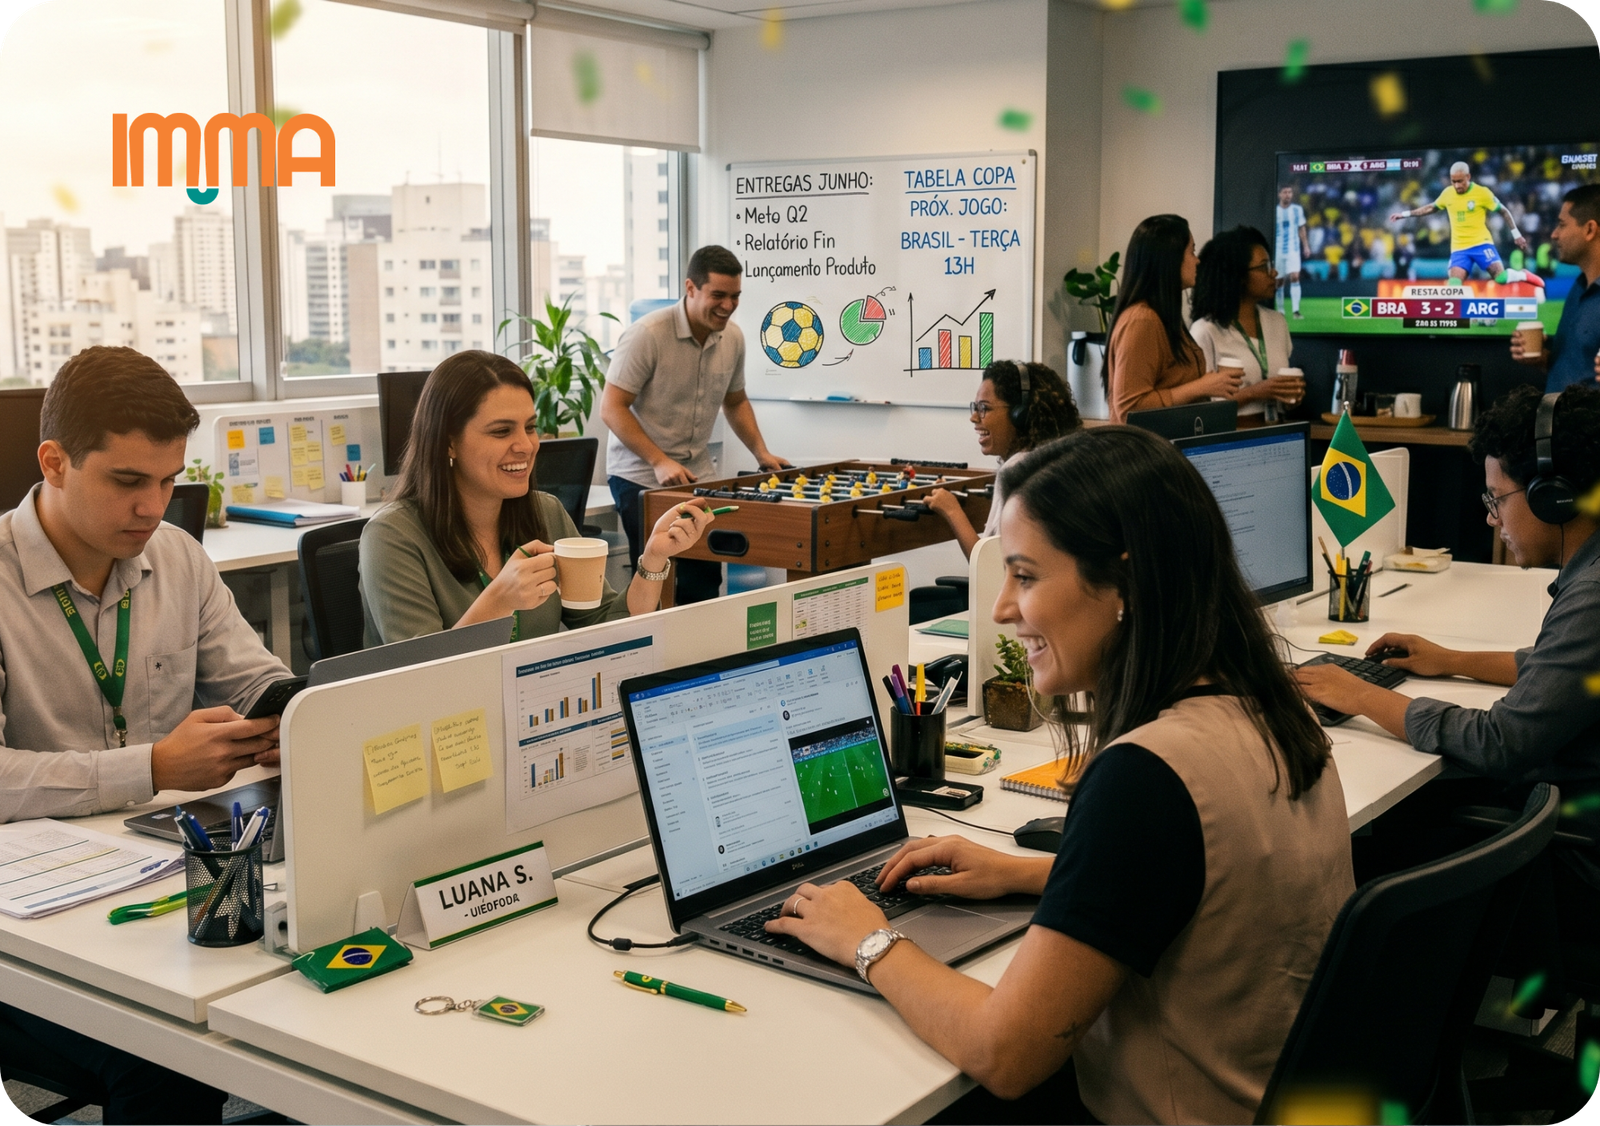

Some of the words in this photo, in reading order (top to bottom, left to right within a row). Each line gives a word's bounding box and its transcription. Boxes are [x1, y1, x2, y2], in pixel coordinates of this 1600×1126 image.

[736, 174, 812, 194] ENTREGAS
[818, 171, 873, 190] JUNHO:
[904, 168, 966, 188] TABELA
[973, 166, 1016, 185] COPA
[787, 205, 808, 223] Q2
[910, 195, 954, 217] PRÓX.
[958, 198, 1008, 216] JOGO:
[745, 232, 809, 251] Relatório
[813, 230, 836, 249] Fin
[901, 231, 955, 250] BRASIL
[970, 229, 1021, 251] TERÇA
[745, 258, 821, 283] Lançamento
[826, 255, 877, 276] Produto
[944, 257, 975, 275] 13H
[1411, 288, 1439, 296] RESTA
[1440, 288, 1464, 296] COPA
[1377, 302, 1408, 315] BRA
[1421, 302, 1431, 315] 3
[1444, 302, 1455, 315] 2
[1466, 302, 1499, 315] ARG
[439, 871, 511, 910] LUANA
[514, 865, 533, 885] S.
